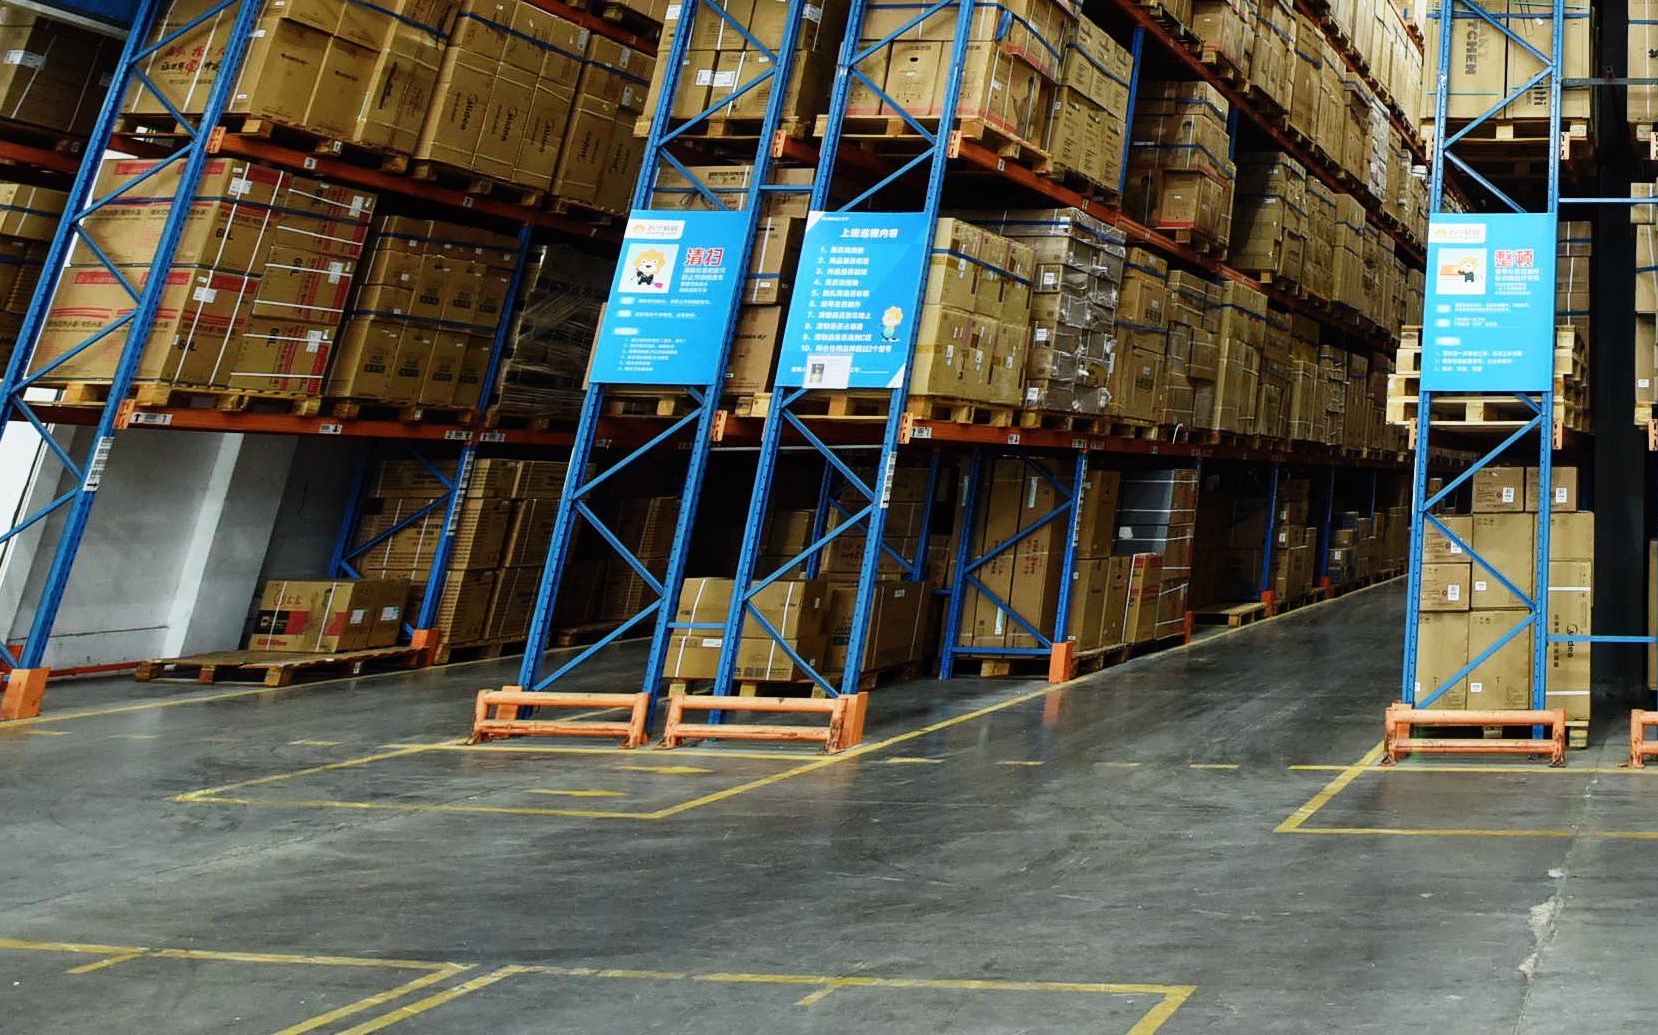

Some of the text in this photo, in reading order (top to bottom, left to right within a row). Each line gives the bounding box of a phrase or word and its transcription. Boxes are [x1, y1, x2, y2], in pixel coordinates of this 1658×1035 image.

[684, 248, 724, 267] 清扫
[1495, 250, 1534, 267] 整顿
[1567, 624, 1578, 658] Mdea
